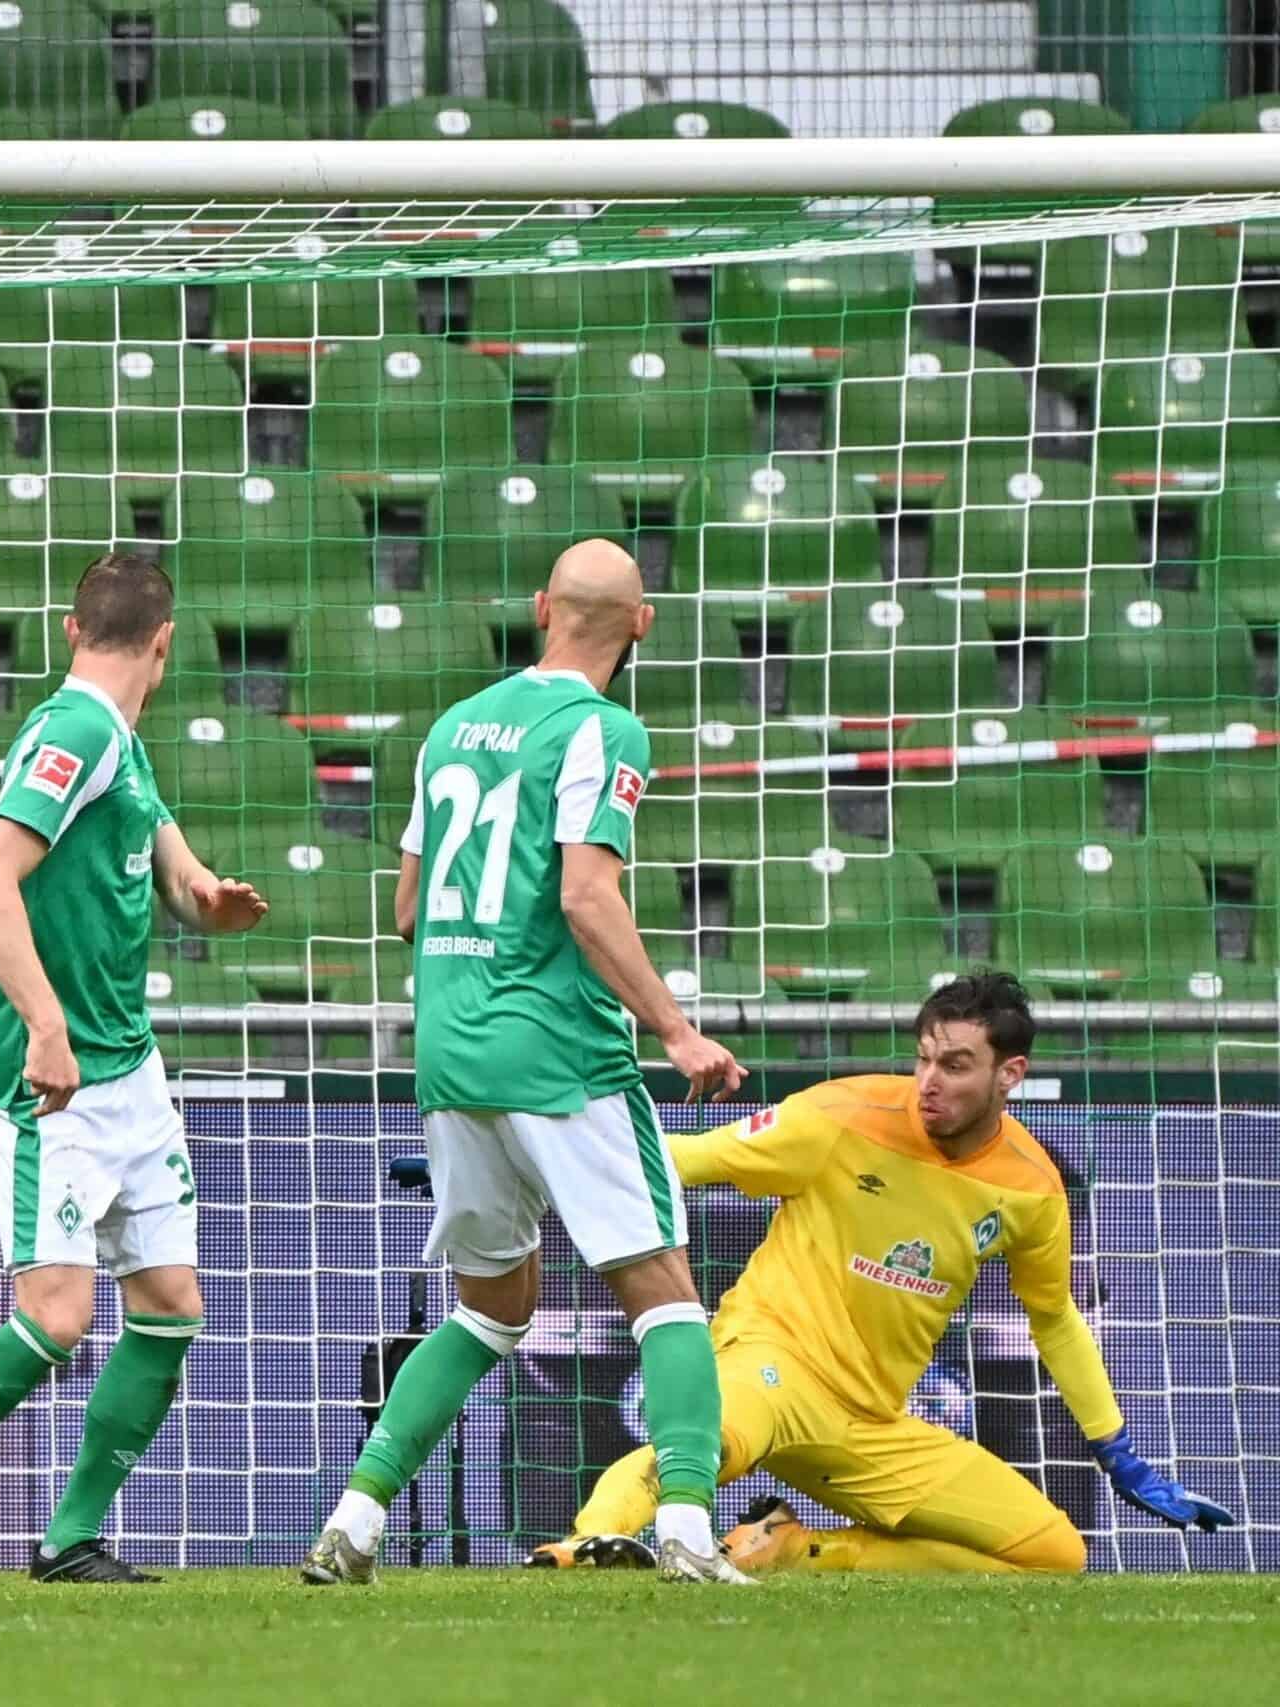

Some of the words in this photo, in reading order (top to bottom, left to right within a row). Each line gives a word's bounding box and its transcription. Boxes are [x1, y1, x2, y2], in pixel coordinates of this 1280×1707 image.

[451, 721, 528, 753] TOPRAK
[426, 762, 523, 925] 21
[852, 1256, 949, 1296] WIESENHOF
